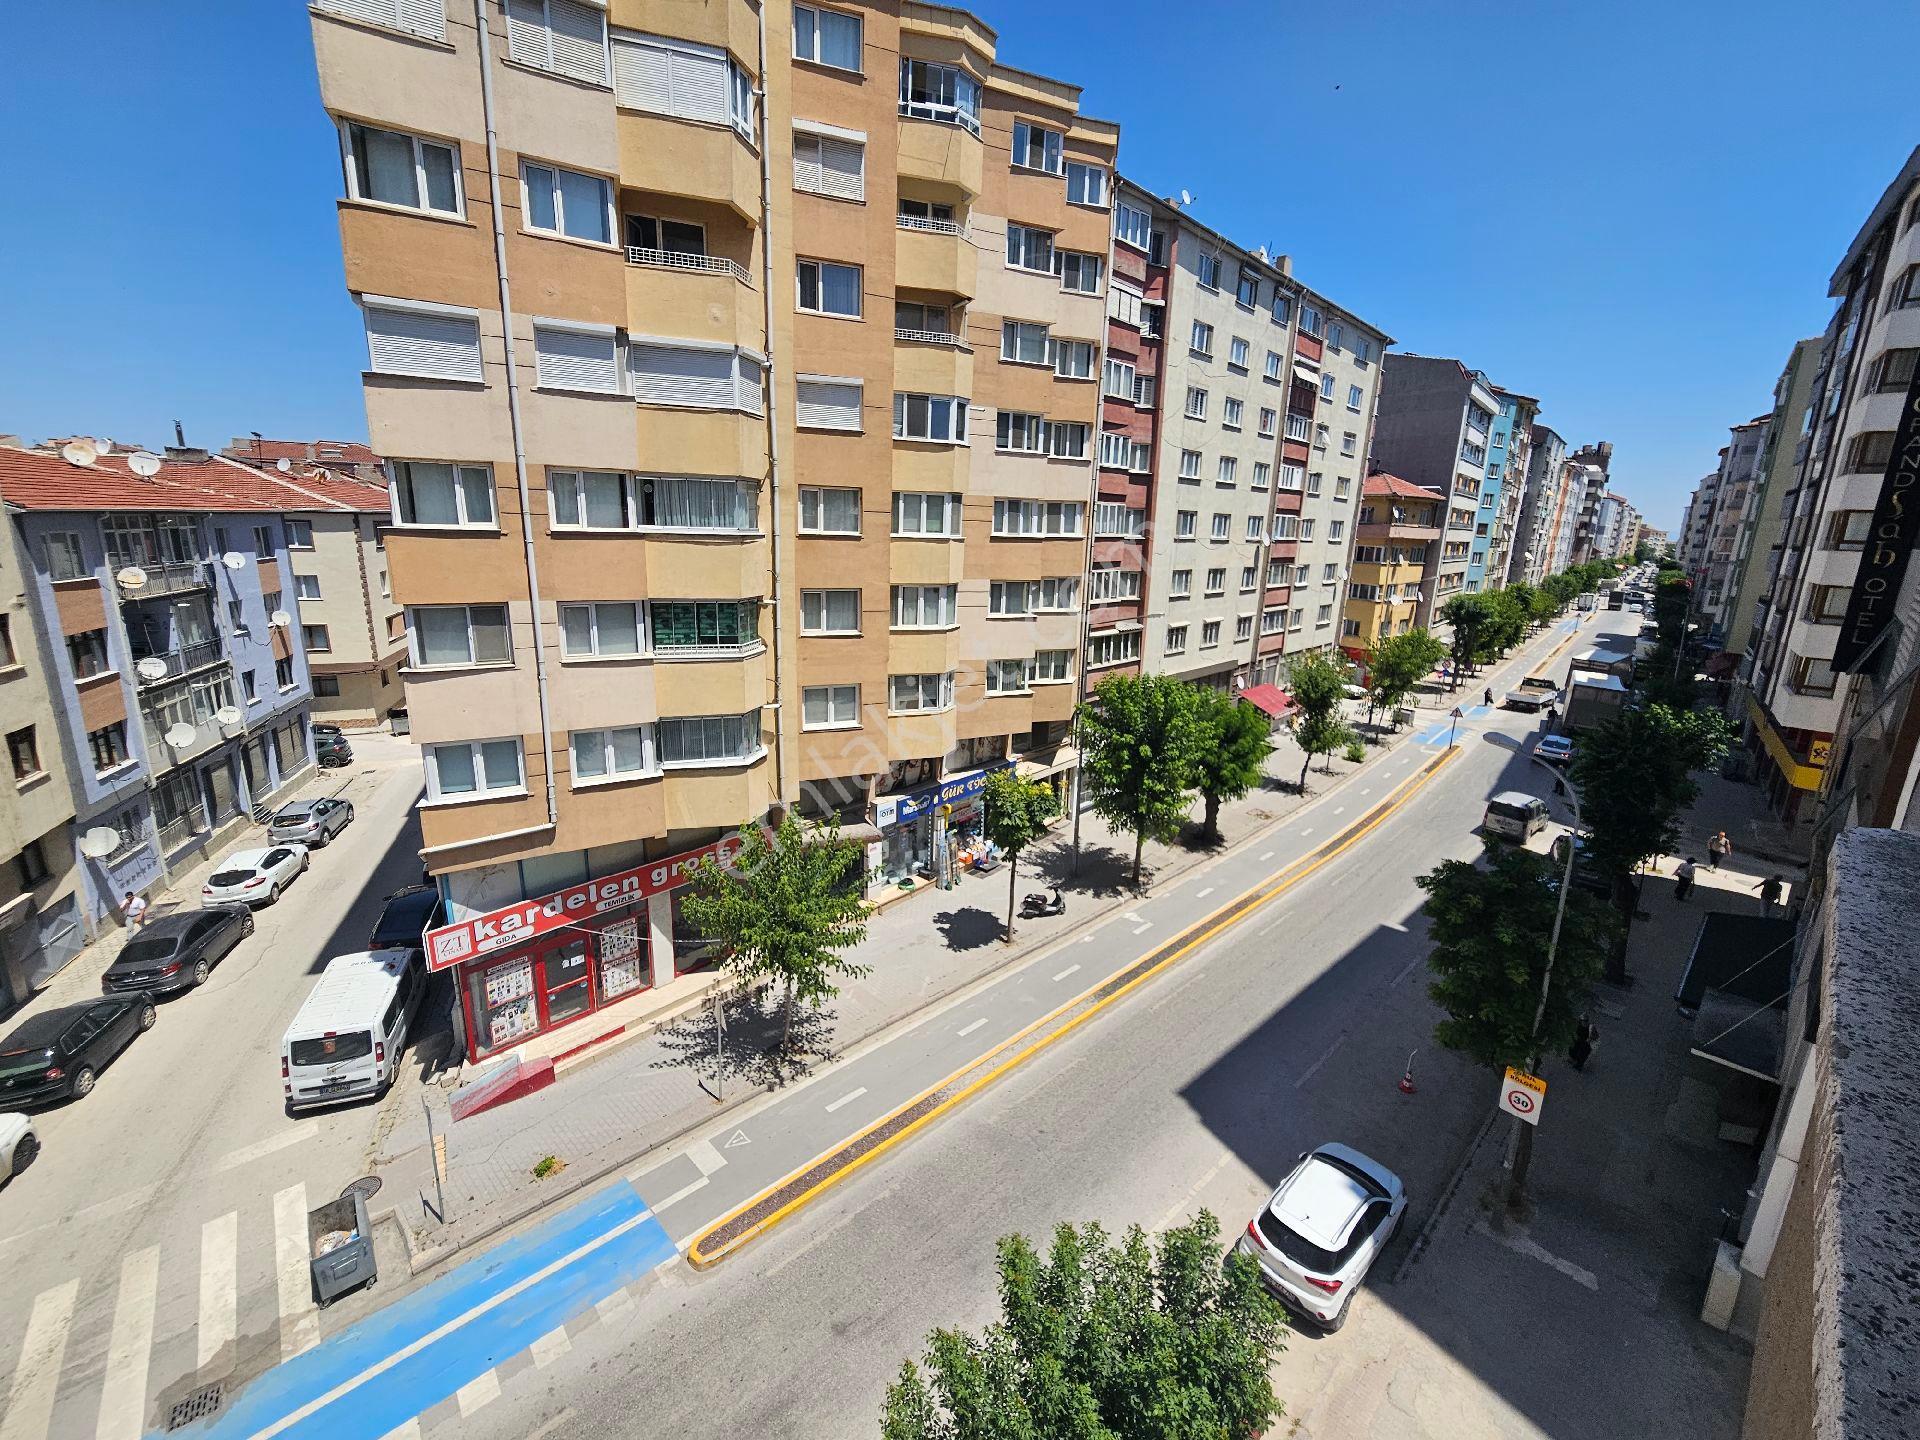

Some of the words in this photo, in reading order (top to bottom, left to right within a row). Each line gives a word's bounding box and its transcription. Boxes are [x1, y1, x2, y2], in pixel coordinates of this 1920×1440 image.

[1852, 577, 1887, 645] OTEL
[474, 876, 640, 942] kardelen
[651, 845, 733, 887] gross
[495, 934, 517, 945] GIDA
[1513, 1096, 1529, 1108] 30
